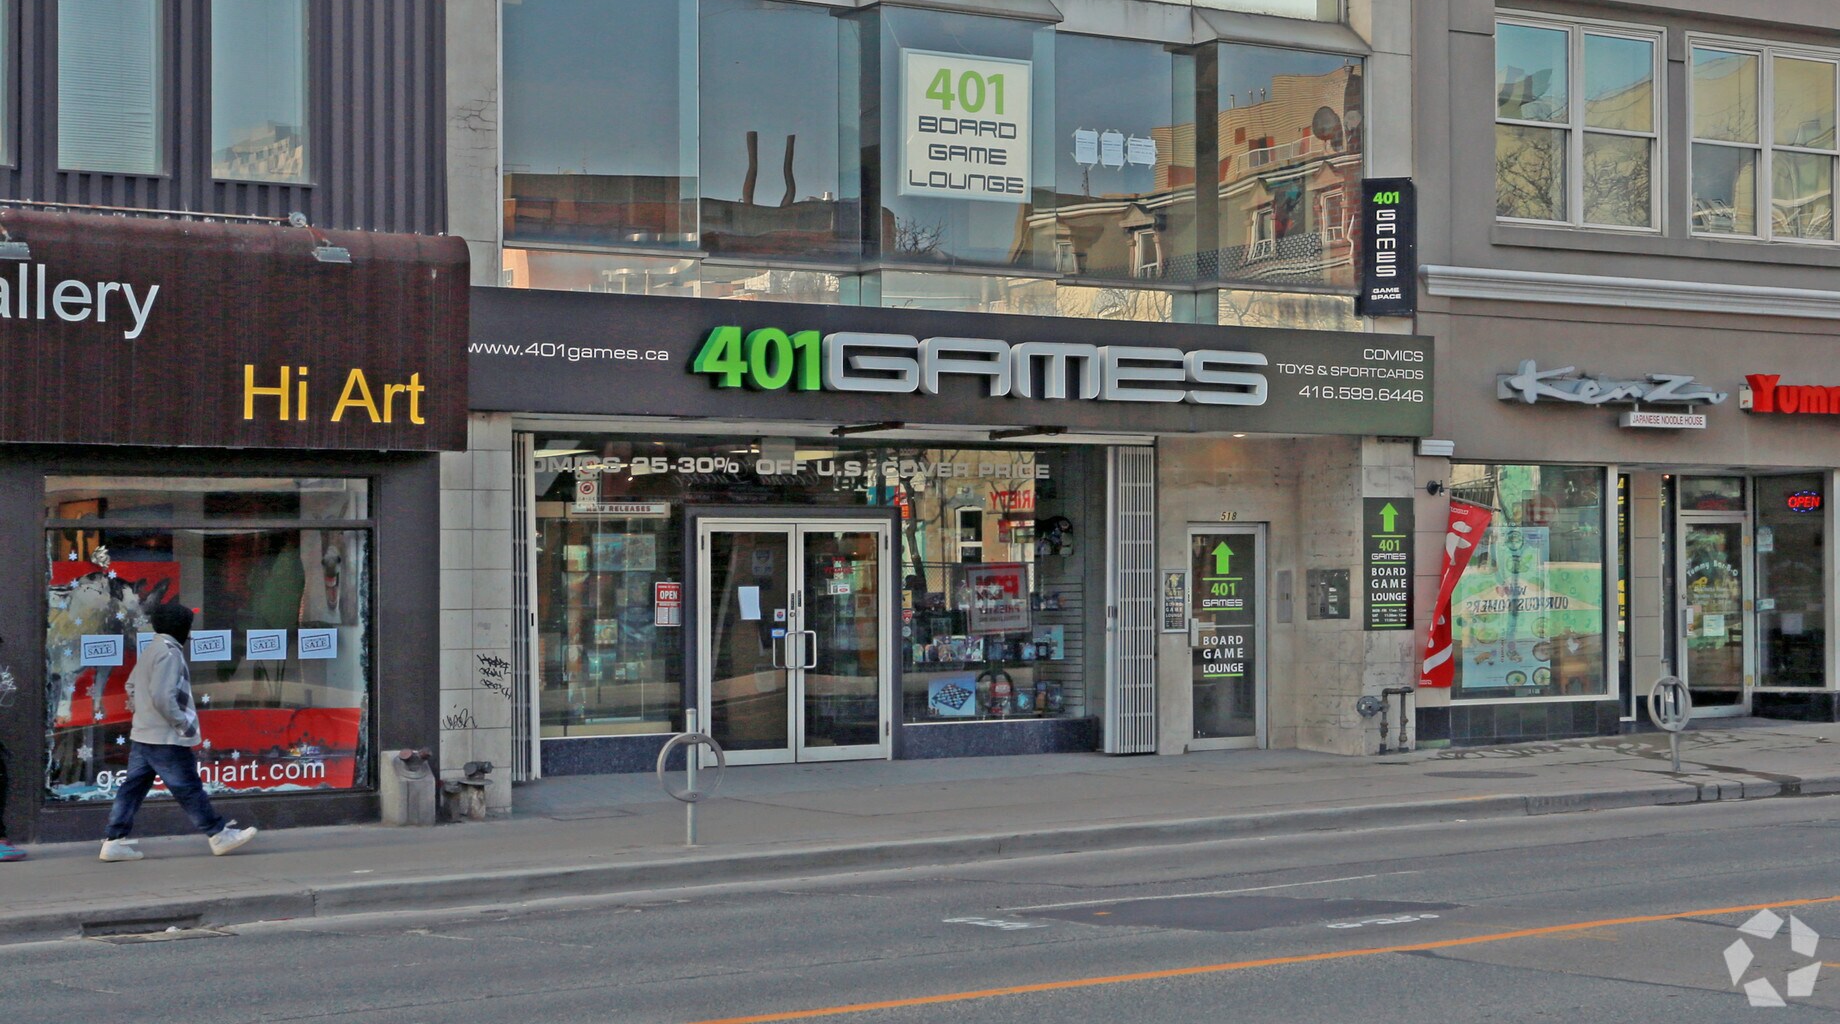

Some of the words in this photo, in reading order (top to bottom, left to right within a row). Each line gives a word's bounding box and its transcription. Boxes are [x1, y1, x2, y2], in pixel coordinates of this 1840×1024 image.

[926, 68, 1005, 115] 401
[918, 116, 1017, 139] BOARD
[928, 143, 1007, 165] GAME
[909, 169, 1024, 193] LOUNGE
[1373, 191, 1400, 205] 401
[1376, 209, 1396, 277] GAMES
[0, 263, 160, 339] llery
[1371, 293, 1402, 301] SPACE
[468, 342, 669, 362] www.401games.ca
[1363, 348, 1424, 363] COMICS
[1277, 363, 1314, 377] TOYS
[1317, 364, 1328, 378] &
[1330, 365, 1424, 381] SPORTCARDS
[243, 364, 308, 421] Hi
[331, 368, 425, 425] Art
[1299, 385, 1424, 403] 416.599.6446
[1632, 414, 1660, 425] JAPANESE
[1661, 415, 1683, 425] NOODLE
[1684, 416, 1703, 426] HOUSE
[756, 458, 806, 476] OFF
[882, 462, 968, 478] COVER
[979, 463, 1050, 479] PRICE
[1787, 496, 1821, 508] OPEN
[1220, 511, 1238, 522] 518
[1378, 539, 1400, 552] 401
[1371, 567, 1406, 576] BOARD
[1211, 582, 1236, 596] 401
[1371, 579, 1407, 589] GAME
[660, 590, 678, 600] OPEN
[1371, 593, 1407, 602] LOUNGE
[1202, 599, 1243, 607] GAMES
[252, 640, 277, 652] SALE
[304, 639, 329, 651] SALE
[1203, 635, 1243, 646] BOARD
[87, 645, 113, 656] SALE
[198, 641, 222, 653] SALE
[1203, 648, 1244, 659] GAME
[1203, 663, 1244, 673] LOUNGE
